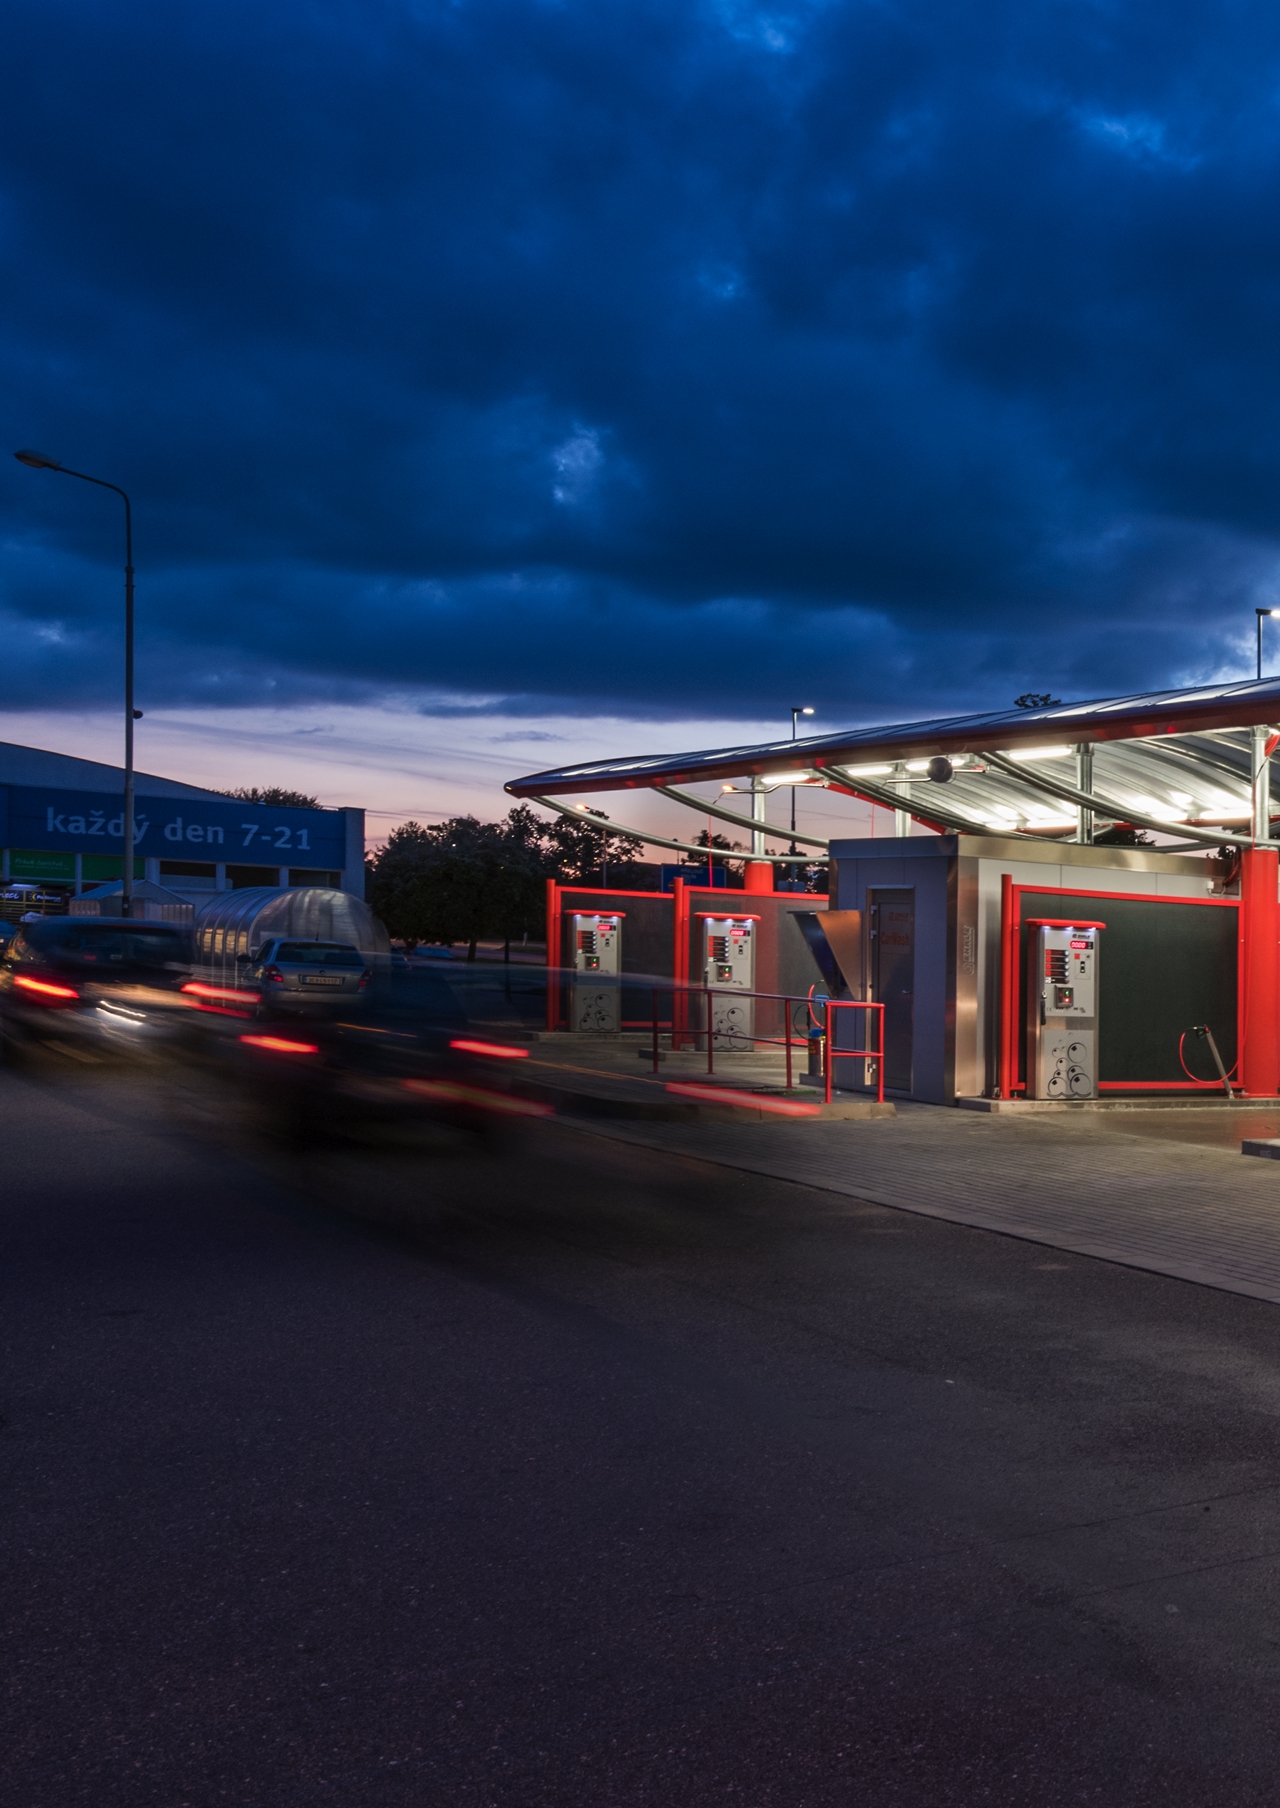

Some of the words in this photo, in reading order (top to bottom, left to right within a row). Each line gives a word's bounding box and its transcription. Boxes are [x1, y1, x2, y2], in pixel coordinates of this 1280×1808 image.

[46, 806, 150, 845] každý
[163, 817, 225, 845] den
[240, 823, 311, 850] 7-21
